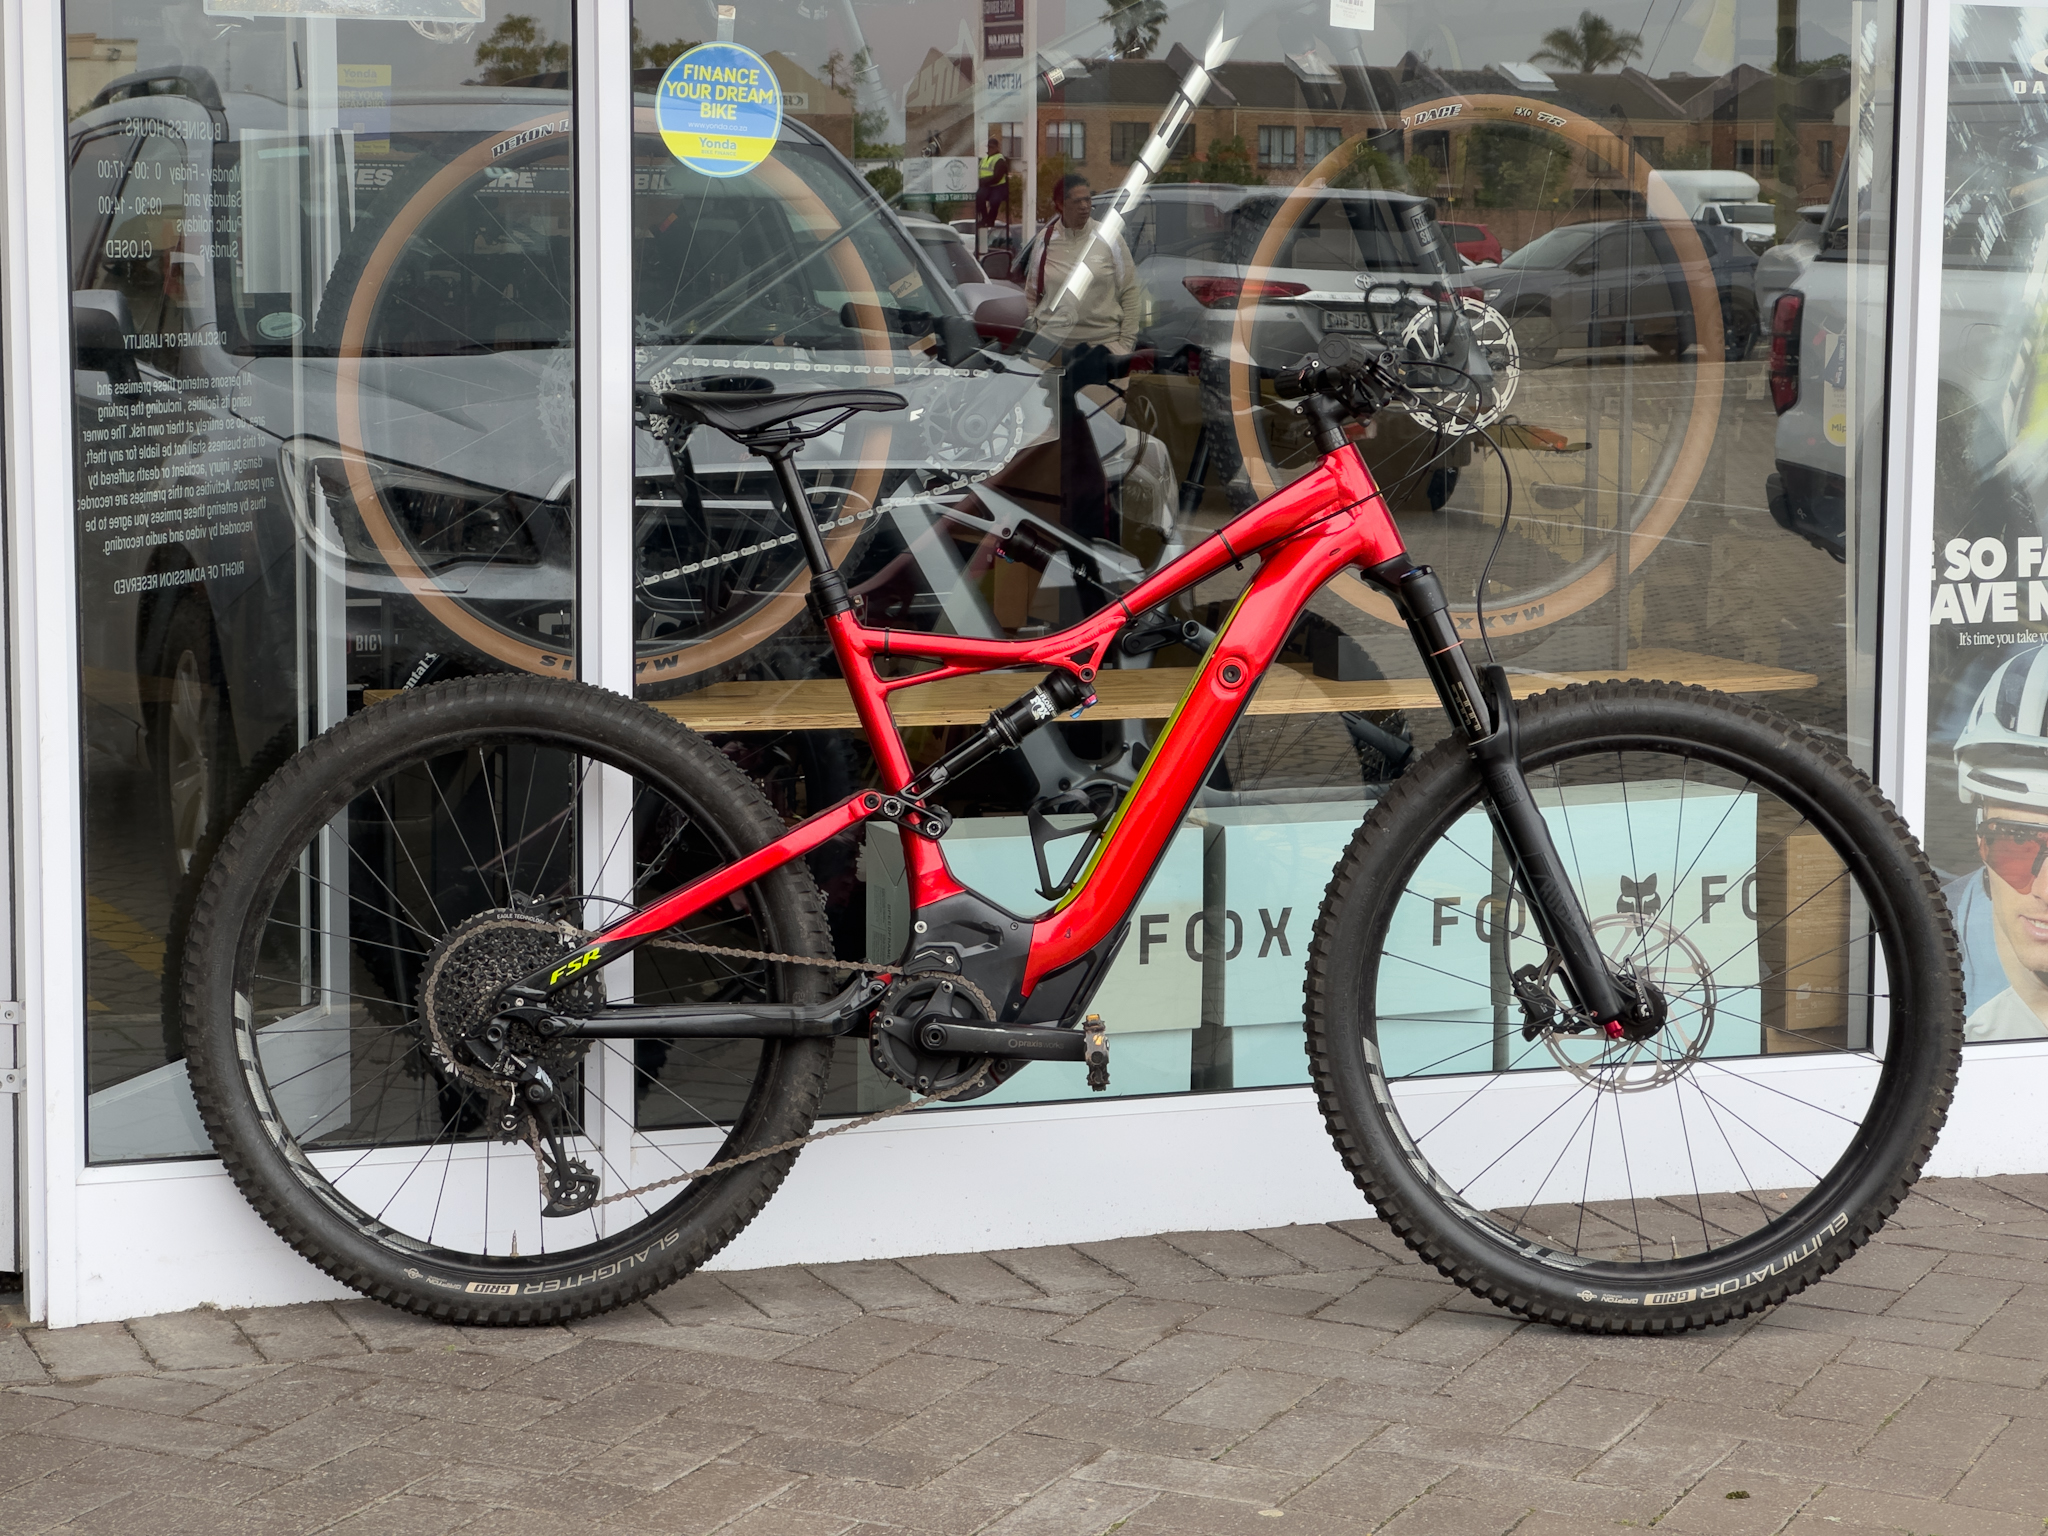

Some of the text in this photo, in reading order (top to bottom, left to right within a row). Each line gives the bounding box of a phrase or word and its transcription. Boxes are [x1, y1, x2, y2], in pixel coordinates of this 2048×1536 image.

[343, 68, 377, 79] Yonda
[683, 64, 760, 85] FINANCE
[358, 90, 384, 100] YOUR
[667, 80, 712, 100] YOUR
[715, 85, 774, 104] DREAM
[366, 100, 386, 109] BIKE
[700, 102, 737, 120] BIKE
[1513, 105, 1533, 118] EXO
[1413, 103, 1463, 127] RACE
[688, 121, 748, 132] www.yonda.co.za
[491, 122, 555, 160] REKON
[699, 137, 737, 150] Yonda
[355, 168, 394, 186] ES
[1943, 536, 2008, 581] SO
[1973, 631, 1995, 646] time
[1996, 633, 2015, 649] you
[2016, 628, 2039, 644] take
[1029, 695, 1050, 721] FOX
[1040, 693, 1054, 712] FLOAT
[1139, 906, 1293, 965] FOX
[549, 946, 602, 986] FSR
[523, 1227, 681, 1296] SLAUGHTER
[1699, 1210, 1849, 1301] ELIMINATOR
[473, 1282, 511, 1294] GRID
[1651, 1291, 1689, 1305] GRID
